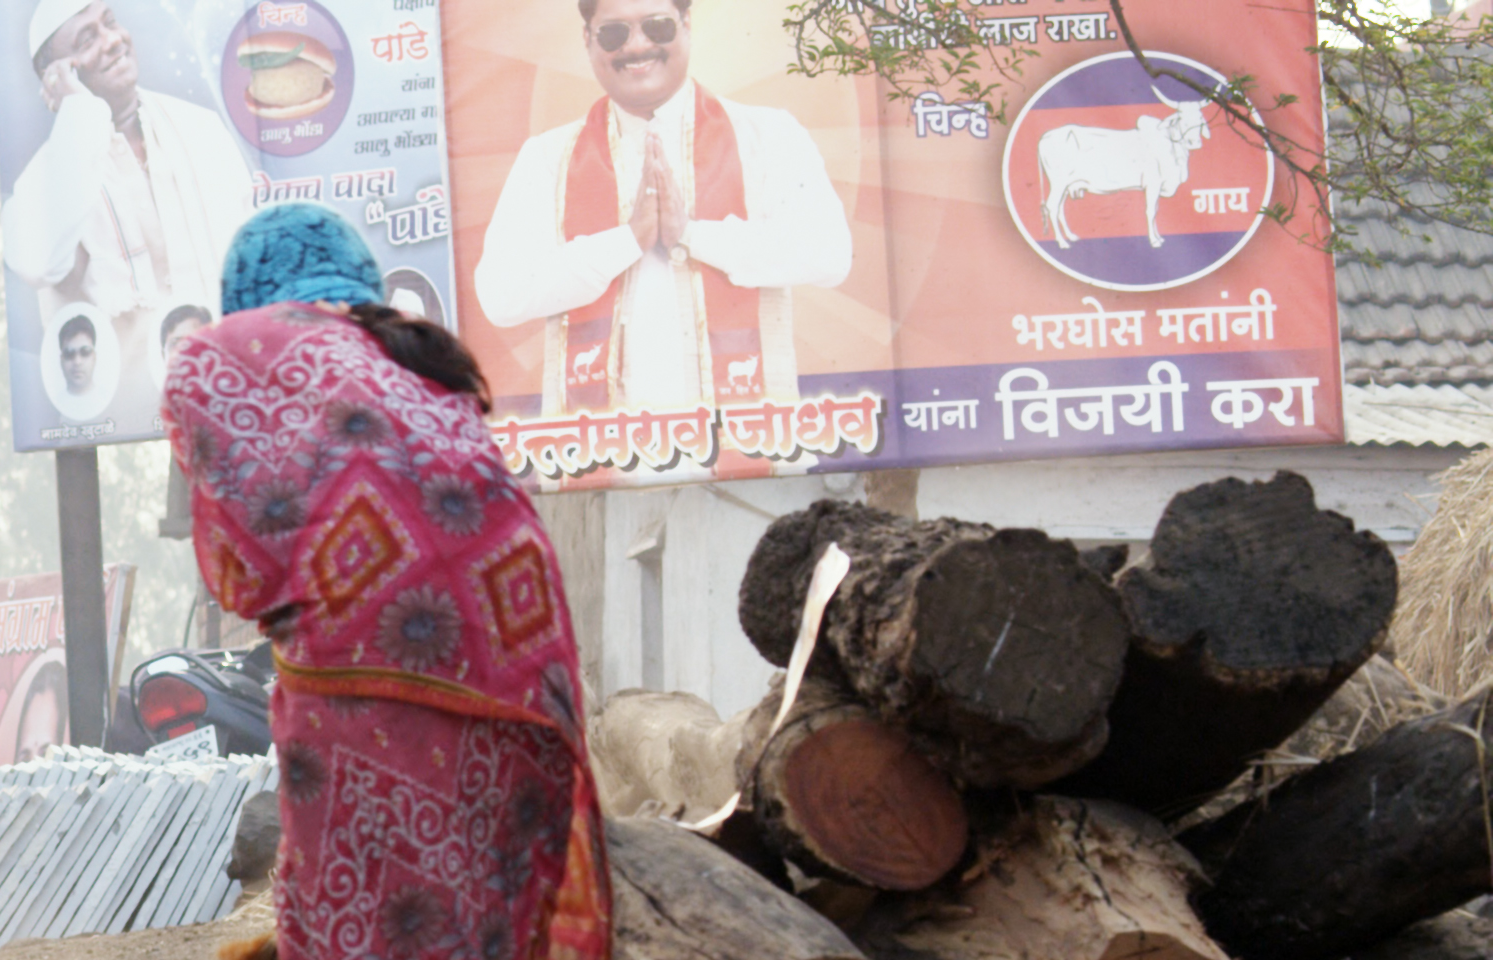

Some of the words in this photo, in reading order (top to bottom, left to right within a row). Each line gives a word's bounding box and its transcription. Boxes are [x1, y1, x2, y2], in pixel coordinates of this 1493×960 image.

[257, 1, 308, 28] चिन्ह
[976, 15, 1039, 45] लाज
[1043, 11, 1117, 42] राखा.
[371, 21, 429, 62] पांडे
[401, 73, 435, 92] यांना
[357, 108, 416, 127] आपल्या
[421, 105, 437, 119] गा
[912, 91, 989, 139] चिन्ह
[332, 167, 397, 200] वादा
[1192, 187, 1250, 214] गाय
[1012, 297, 1145, 351] भरघोस
[1157, 289, 1276, 345] मतांनी
[721, 393, 882, 458] जाधव
[903, 389, 978, 432] यांना
[995, 361, 1188, 440] विजयी
[1207, 376, 1319, 429] करा
